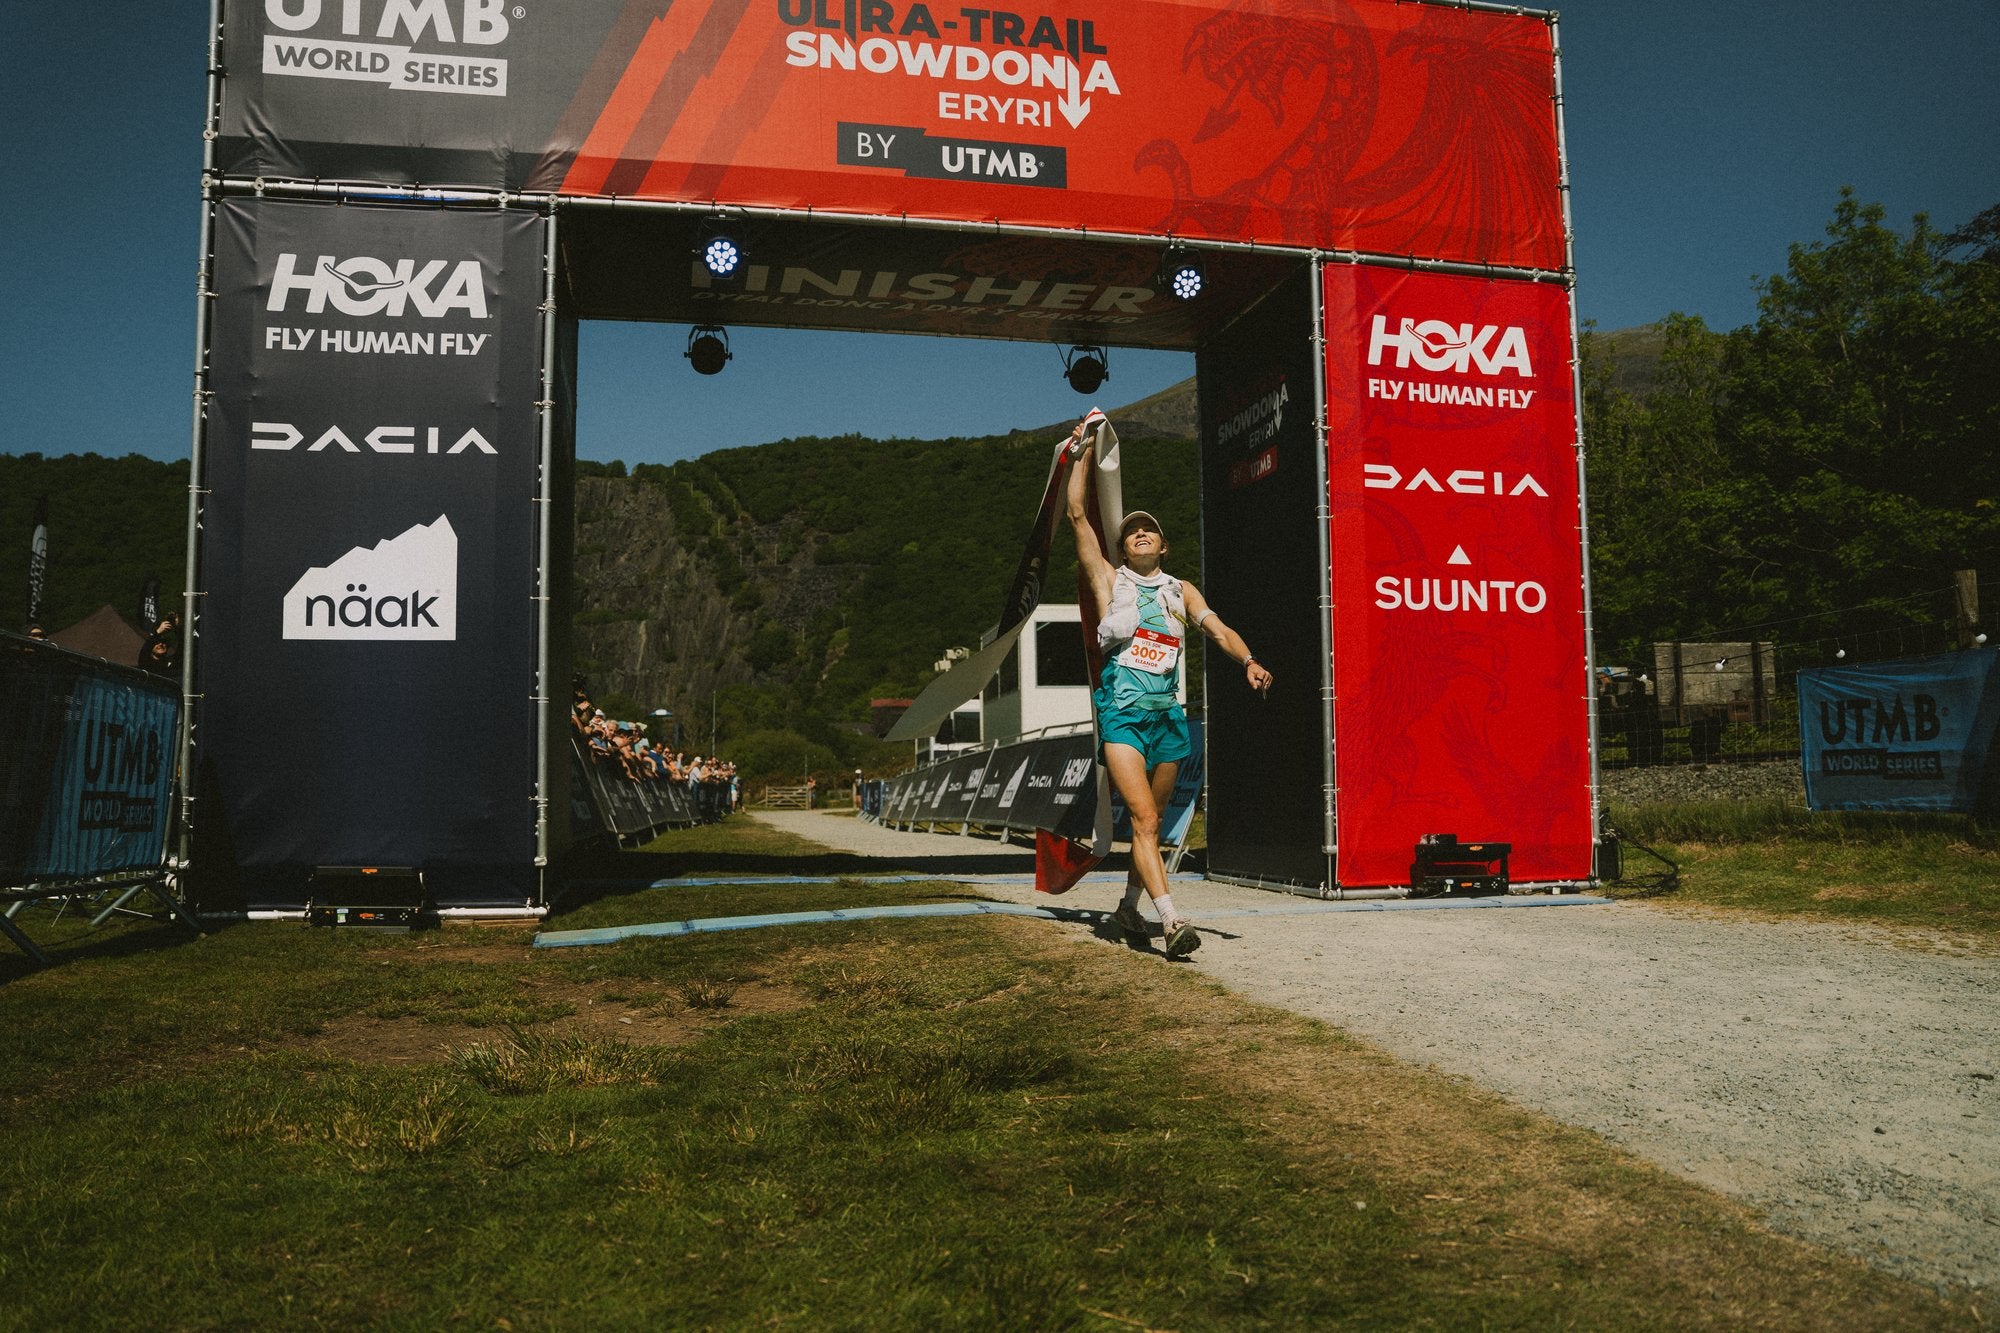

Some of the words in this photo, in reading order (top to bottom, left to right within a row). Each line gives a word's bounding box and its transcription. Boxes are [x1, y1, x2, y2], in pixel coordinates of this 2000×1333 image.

[274, 44, 390, 74] WORLD
[403, 61, 499, 88] SERIES
[785, 31, 1121, 96] SNOWDONIA
[938, 91, 1052, 128] ERYRI
[857, 132, 896, 159] BY
[266, 253, 488, 319] HOKA
[793, 297, 891, 309] DONC
[265, 326, 316, 351] FLY
[320, 329, 435, 355] HUMAN
[440, 333, 488, 356] FLY
[1367, 314, 1533, 378] HOKA
[1368, 378, 1404, 401] FLY
[1408, 383, 1493, 408] HUMAN
[1497, 388, 1533, 409] FLY
[251, 422, 498, 454] DACIA
[1248, 419, 1274, 449] ERYRI
[1250, 454, 1271, 479] UTMB
[1364, 463, 1549, 497] DACIA
[305, 583, 440, 628] näak
[1375, 575, 1547, 614] SUUNTO
[1131, 644, 1167, 662] 3007
[1820, 694, 1941, 746] UTMB
[84, 720, 160, 785] UTMB
[1827, 753, 1881, 772] WORLD
[1886, 757, 1937, 776] SERIES
[1028, 775, 1053, 788] DACIA
[83, 798, 121, 822] WORLD
